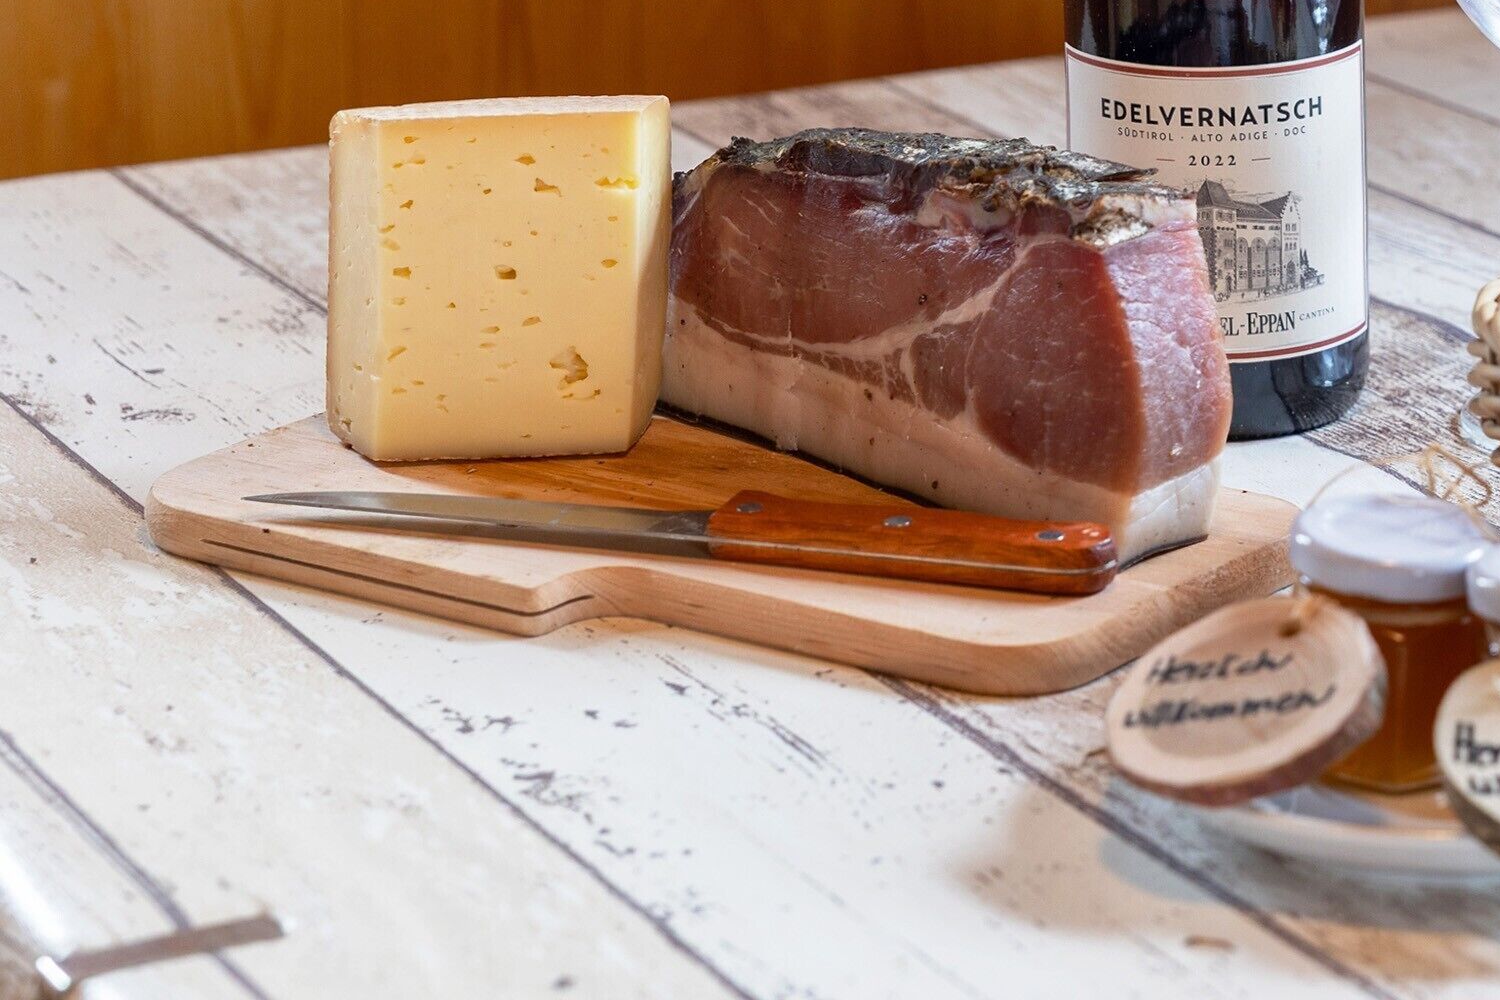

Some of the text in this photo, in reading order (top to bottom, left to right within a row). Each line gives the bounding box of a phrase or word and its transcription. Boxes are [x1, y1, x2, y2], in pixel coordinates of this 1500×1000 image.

[1101, 96, 1323, 127] EDELVERNATSCH
[1117, 125, 1306, 142] SÜDTIROL ALTO ADIGE DOC
[1188, 154, 1237, 167] 2022
[1220, 307, 1335, 337] EL-EPPAN CANTINA
[1146, 650, 1294, 684] Herzlich
